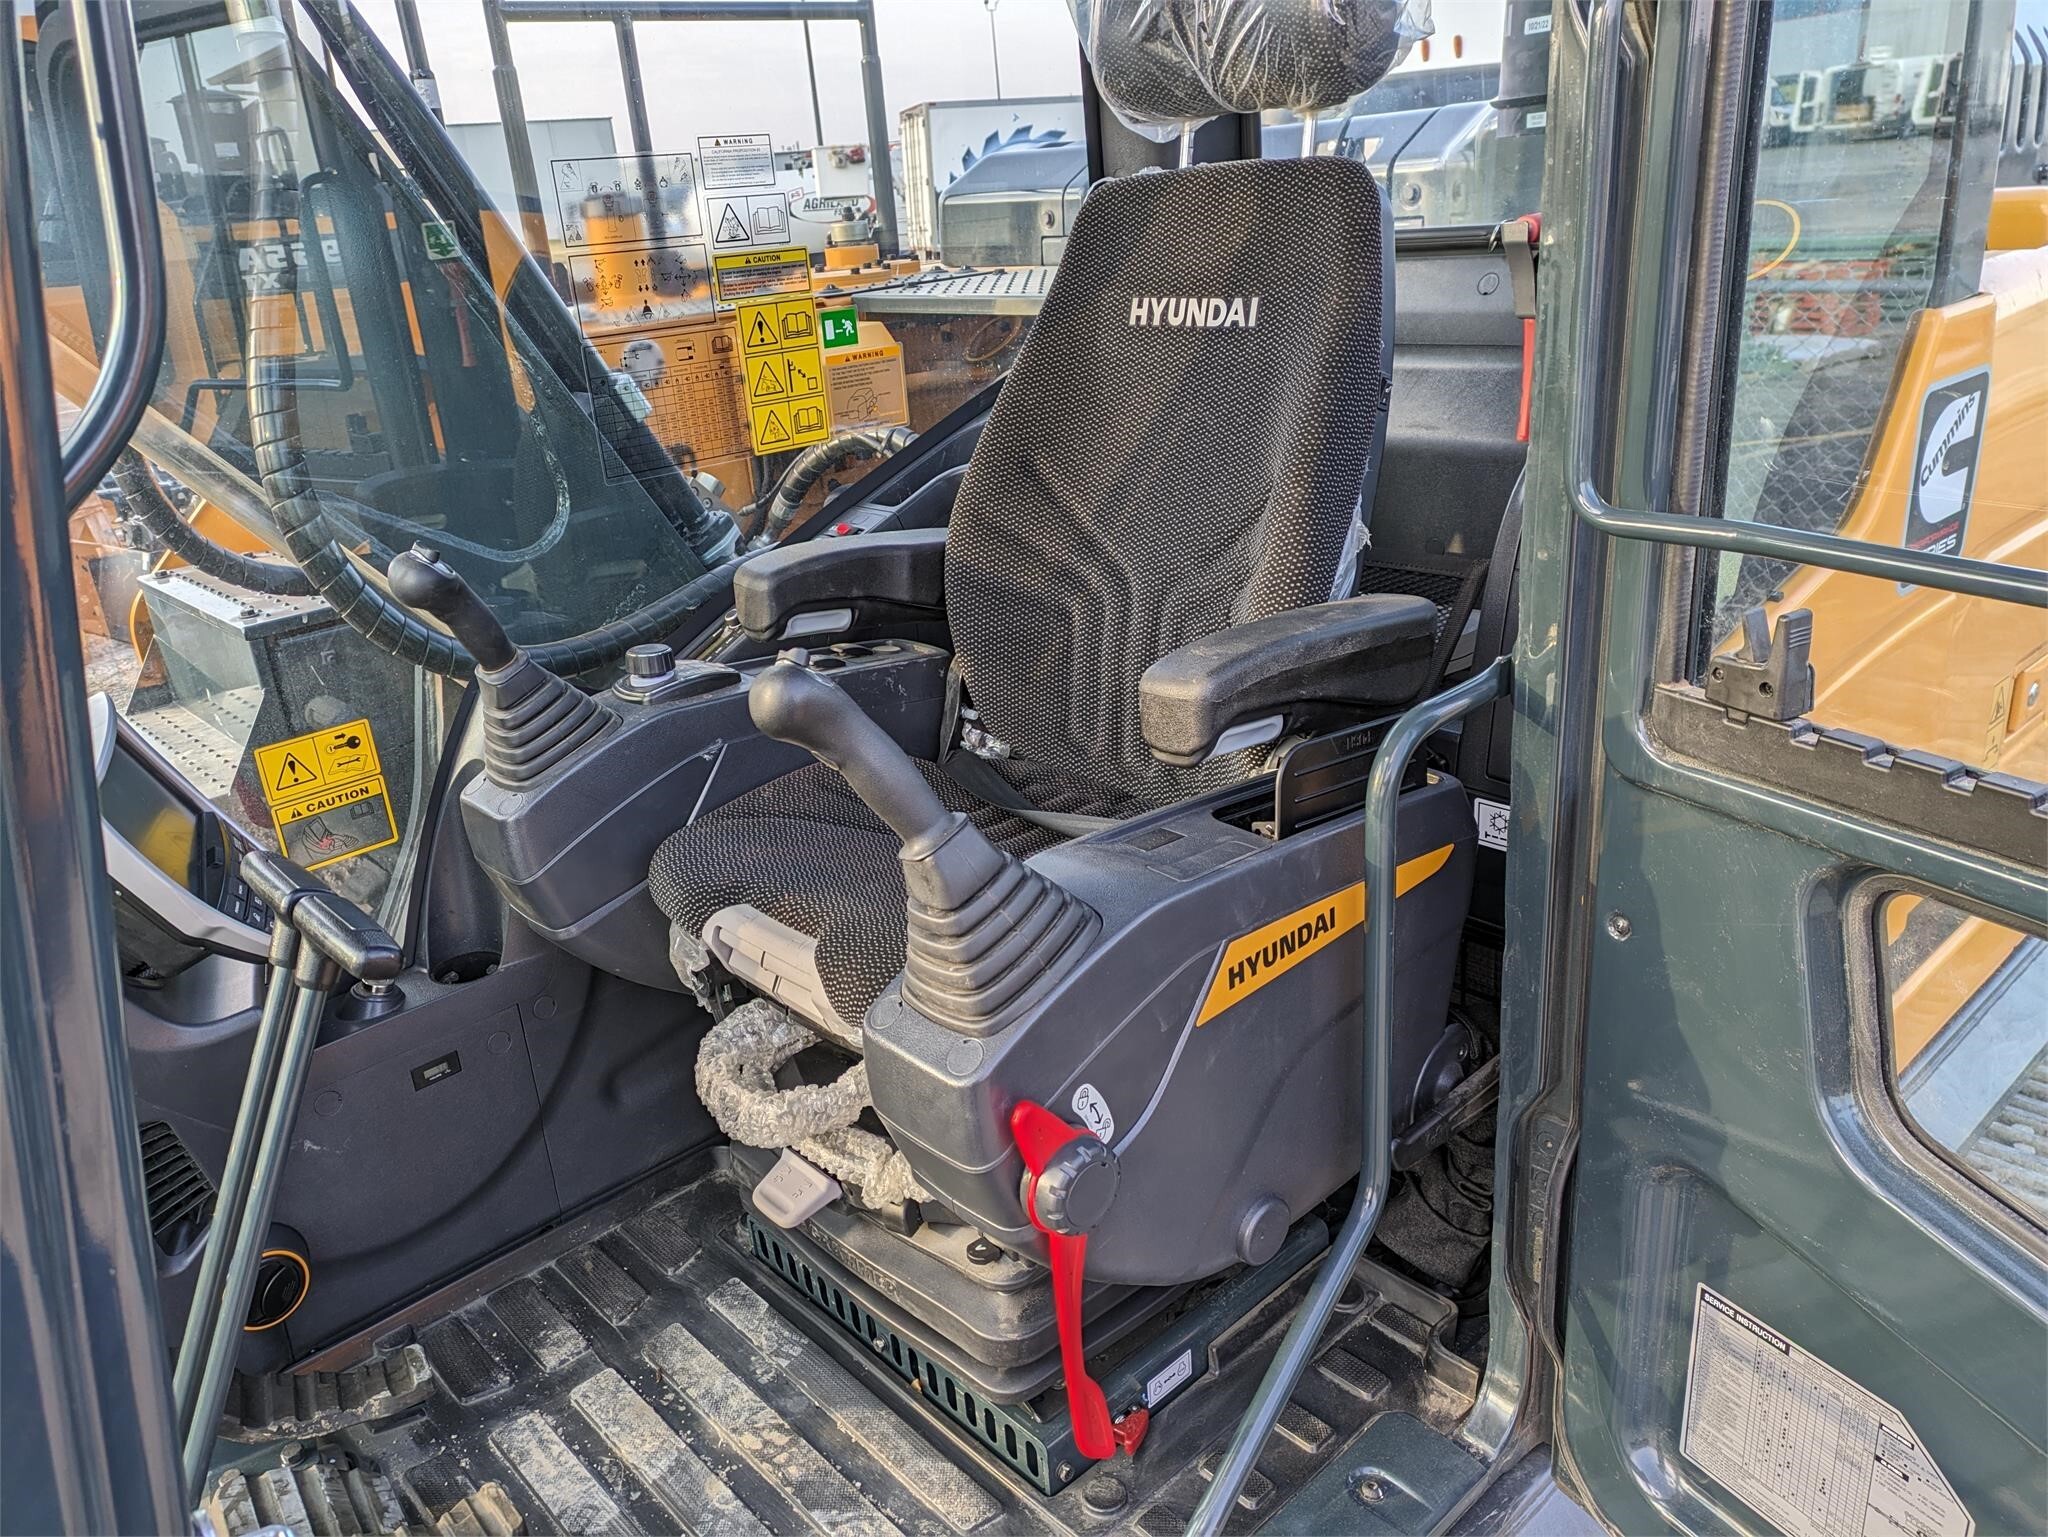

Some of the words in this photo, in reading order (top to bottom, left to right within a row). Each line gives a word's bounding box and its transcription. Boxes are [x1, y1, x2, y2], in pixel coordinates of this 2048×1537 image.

[753, 254, 781, 264] CAUTION
[1129, 297, 1259, 327] HYUNDAI
[852, 350, 884, 361] WARNING
[1919, 393, 1976, 487] Cummins
[306, 786, 369, 813] CAUTION
[1228, 906, 1336, 991] HYUNDAI
[1704, 1293, 1735, 1318] SERVICE
[1736, 1314, 1786, 1351] INSTRUCTION
